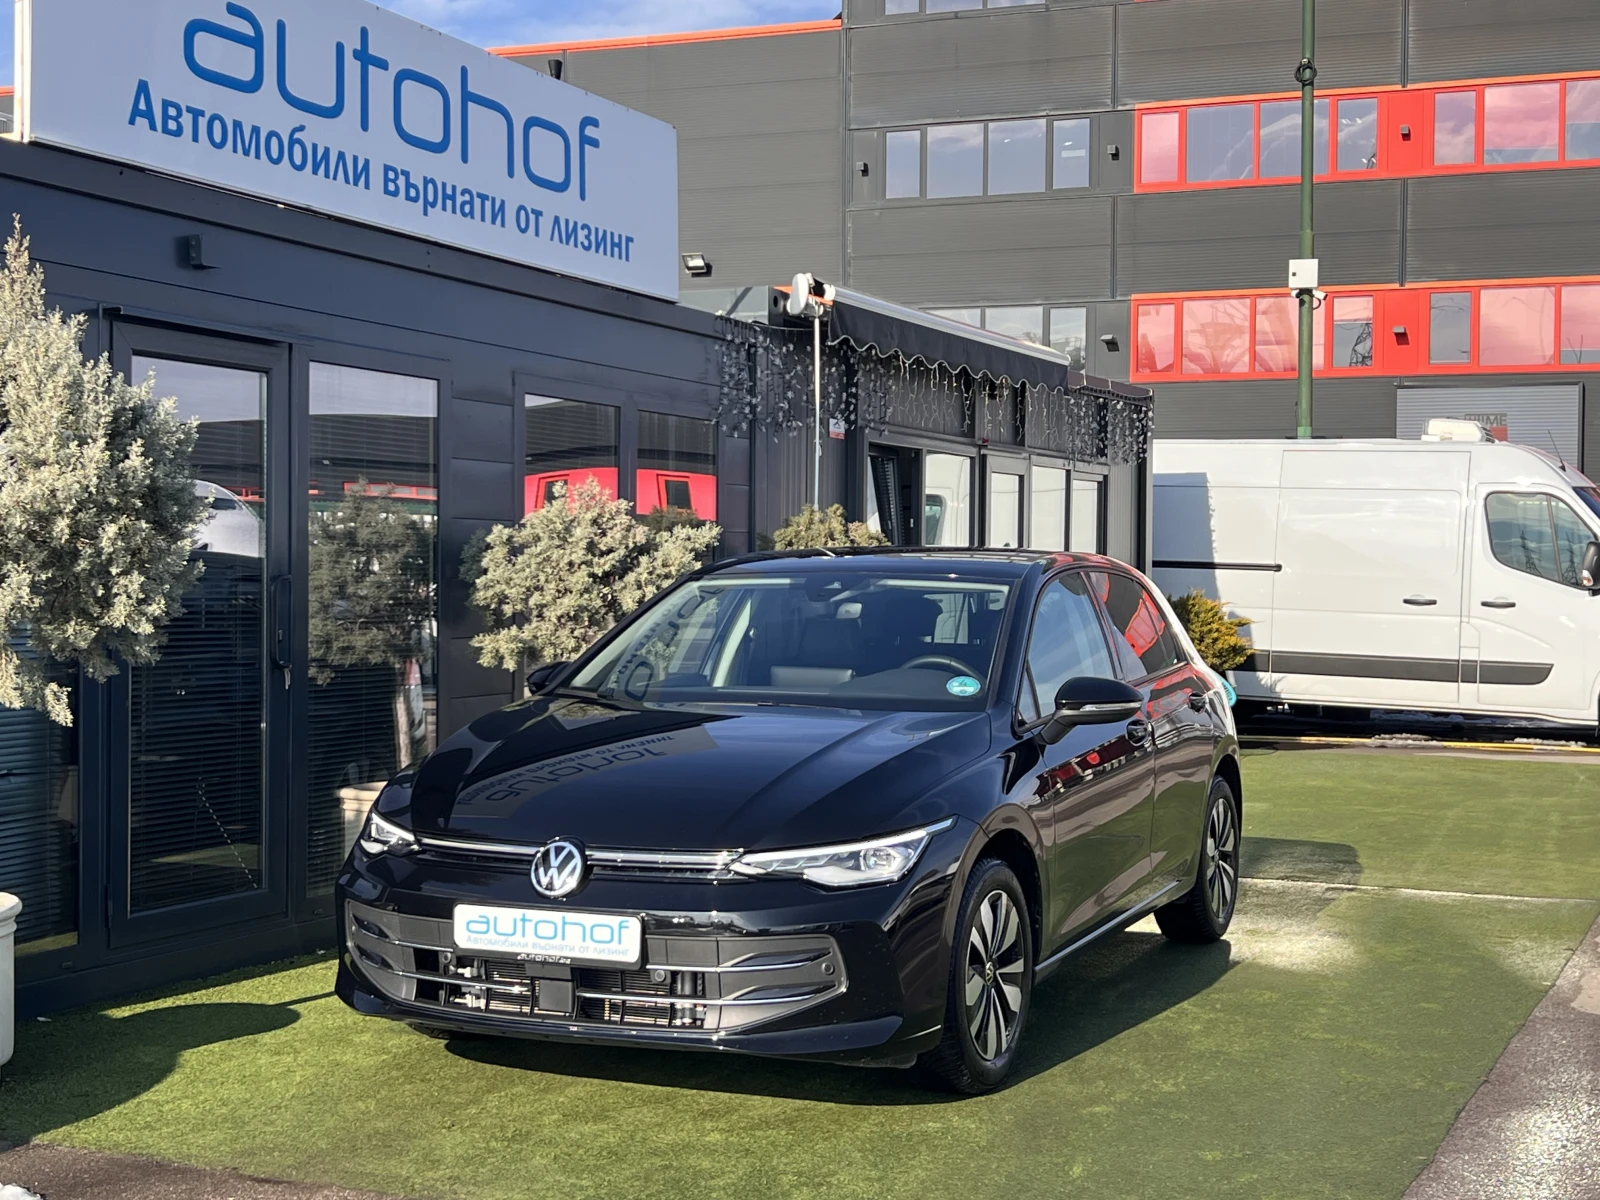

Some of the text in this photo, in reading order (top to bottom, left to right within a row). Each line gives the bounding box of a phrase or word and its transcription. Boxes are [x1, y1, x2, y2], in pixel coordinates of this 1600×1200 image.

[183, 0, 600, 202] autohof
[128, 78, 635, 263] Автомобили върнати от лизинг
[465, 913, 630, 945] autohof
[466, 935, 529, 949] Автомобили
[532, 942, 576, 953] върнати
[578, 944, 590, 954] от
